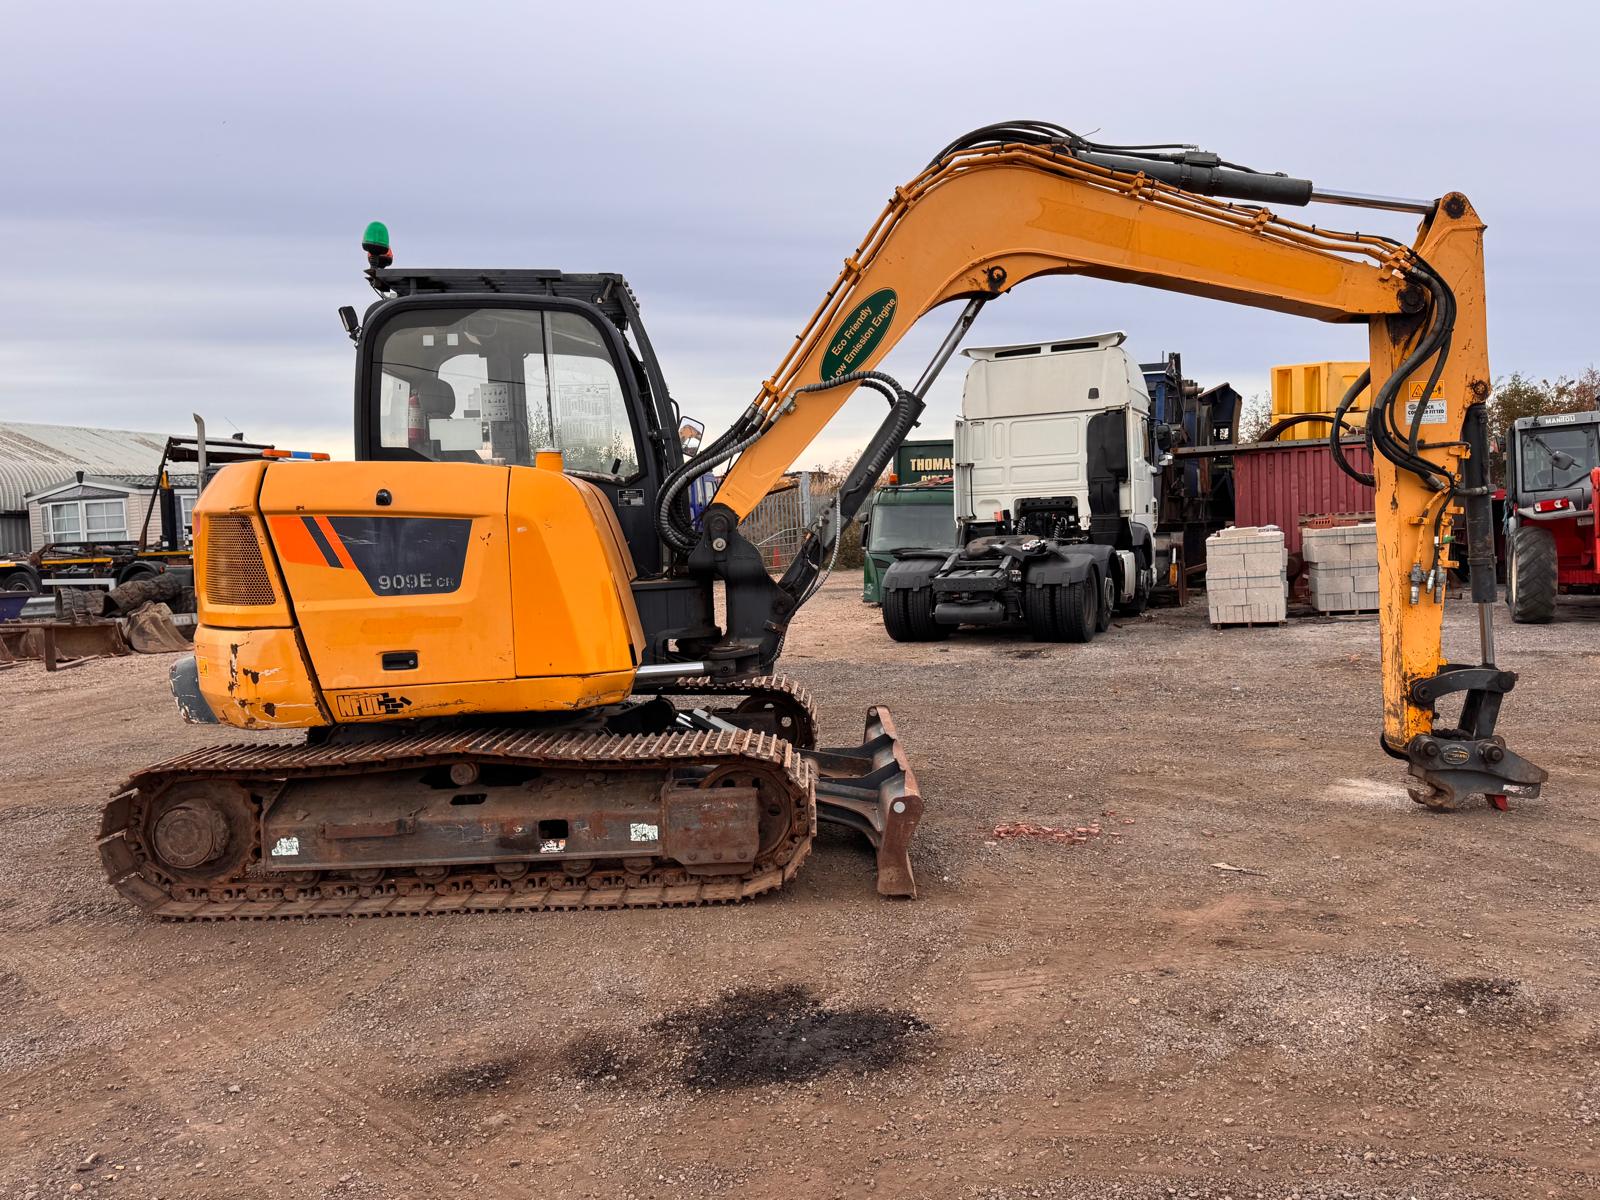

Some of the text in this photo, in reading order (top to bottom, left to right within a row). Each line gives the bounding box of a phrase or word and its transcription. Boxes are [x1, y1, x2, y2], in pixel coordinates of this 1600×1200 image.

[832, 305, 873, 356] Eco Friendly
[844, 326, 875, 364] Emission
[872, 298, 897, 328] Engine
[1545, 415, 1576, 424] MANITOU
[378, 573, 433, 590] 909E
